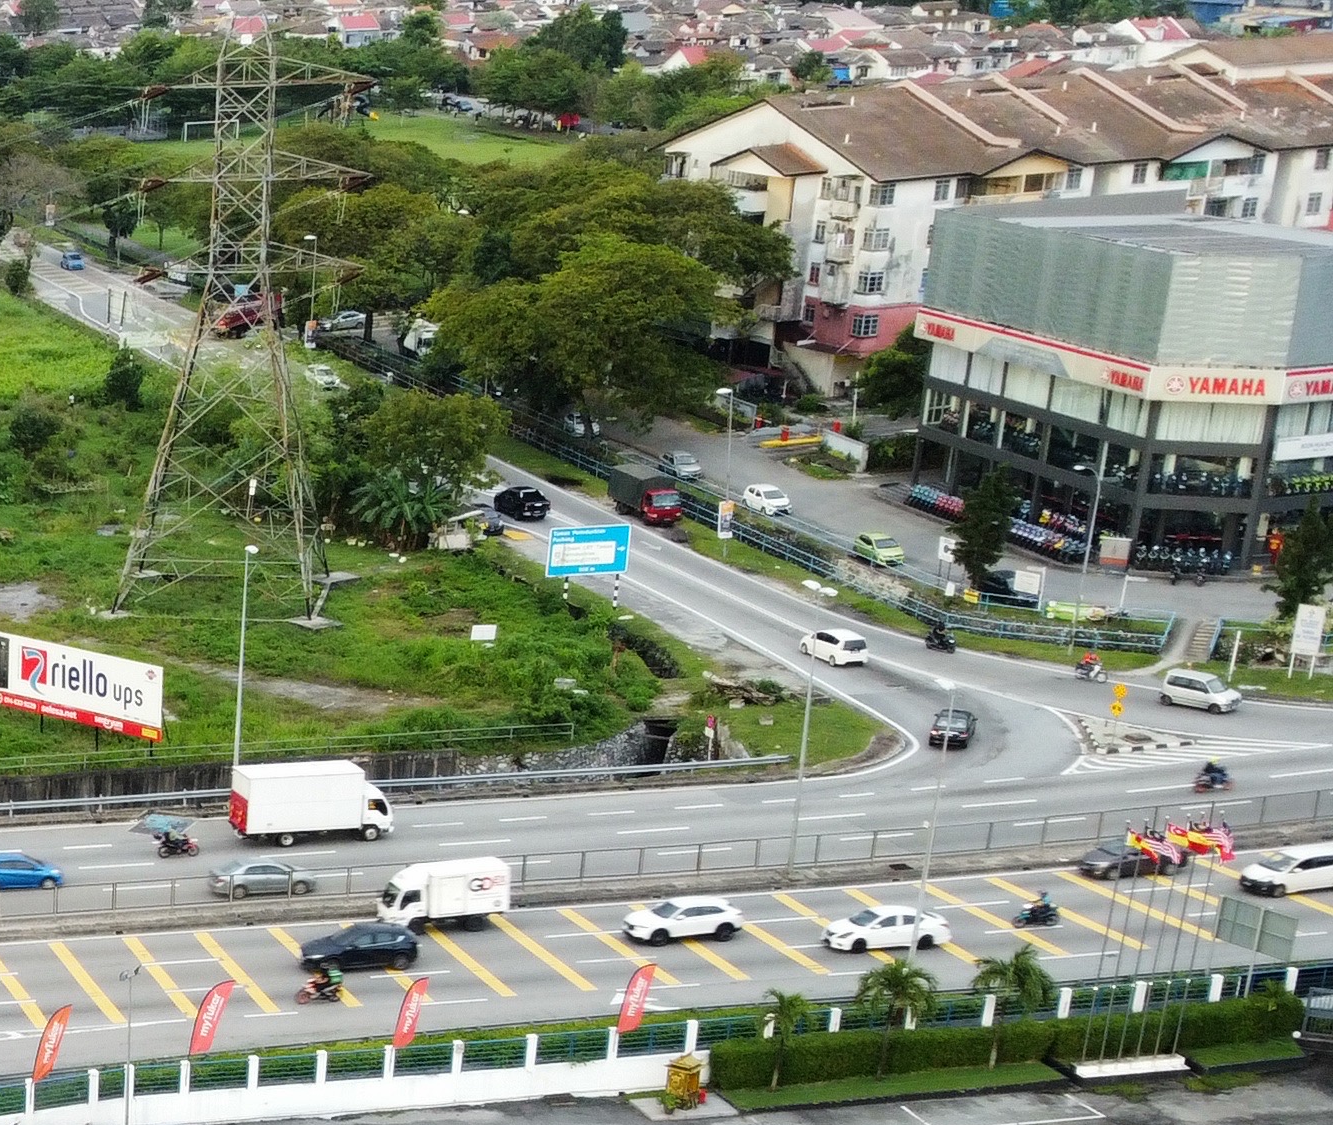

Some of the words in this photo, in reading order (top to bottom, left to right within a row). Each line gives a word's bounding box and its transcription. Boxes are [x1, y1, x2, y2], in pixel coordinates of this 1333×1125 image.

[1110, 368, 1145, 393] YAMAHA
[1189, 376, 1265, 396] YAMAHA
[1305, 379, 1333, 397] YAM
[50, 654, 108, 698] riello
[113, 683, 144, 710] ups
[199, 993, 222, 1038] myTukar
[402, 991, 420, 1035] myTukar
[42, 1021, 60, 1064] myTukar
